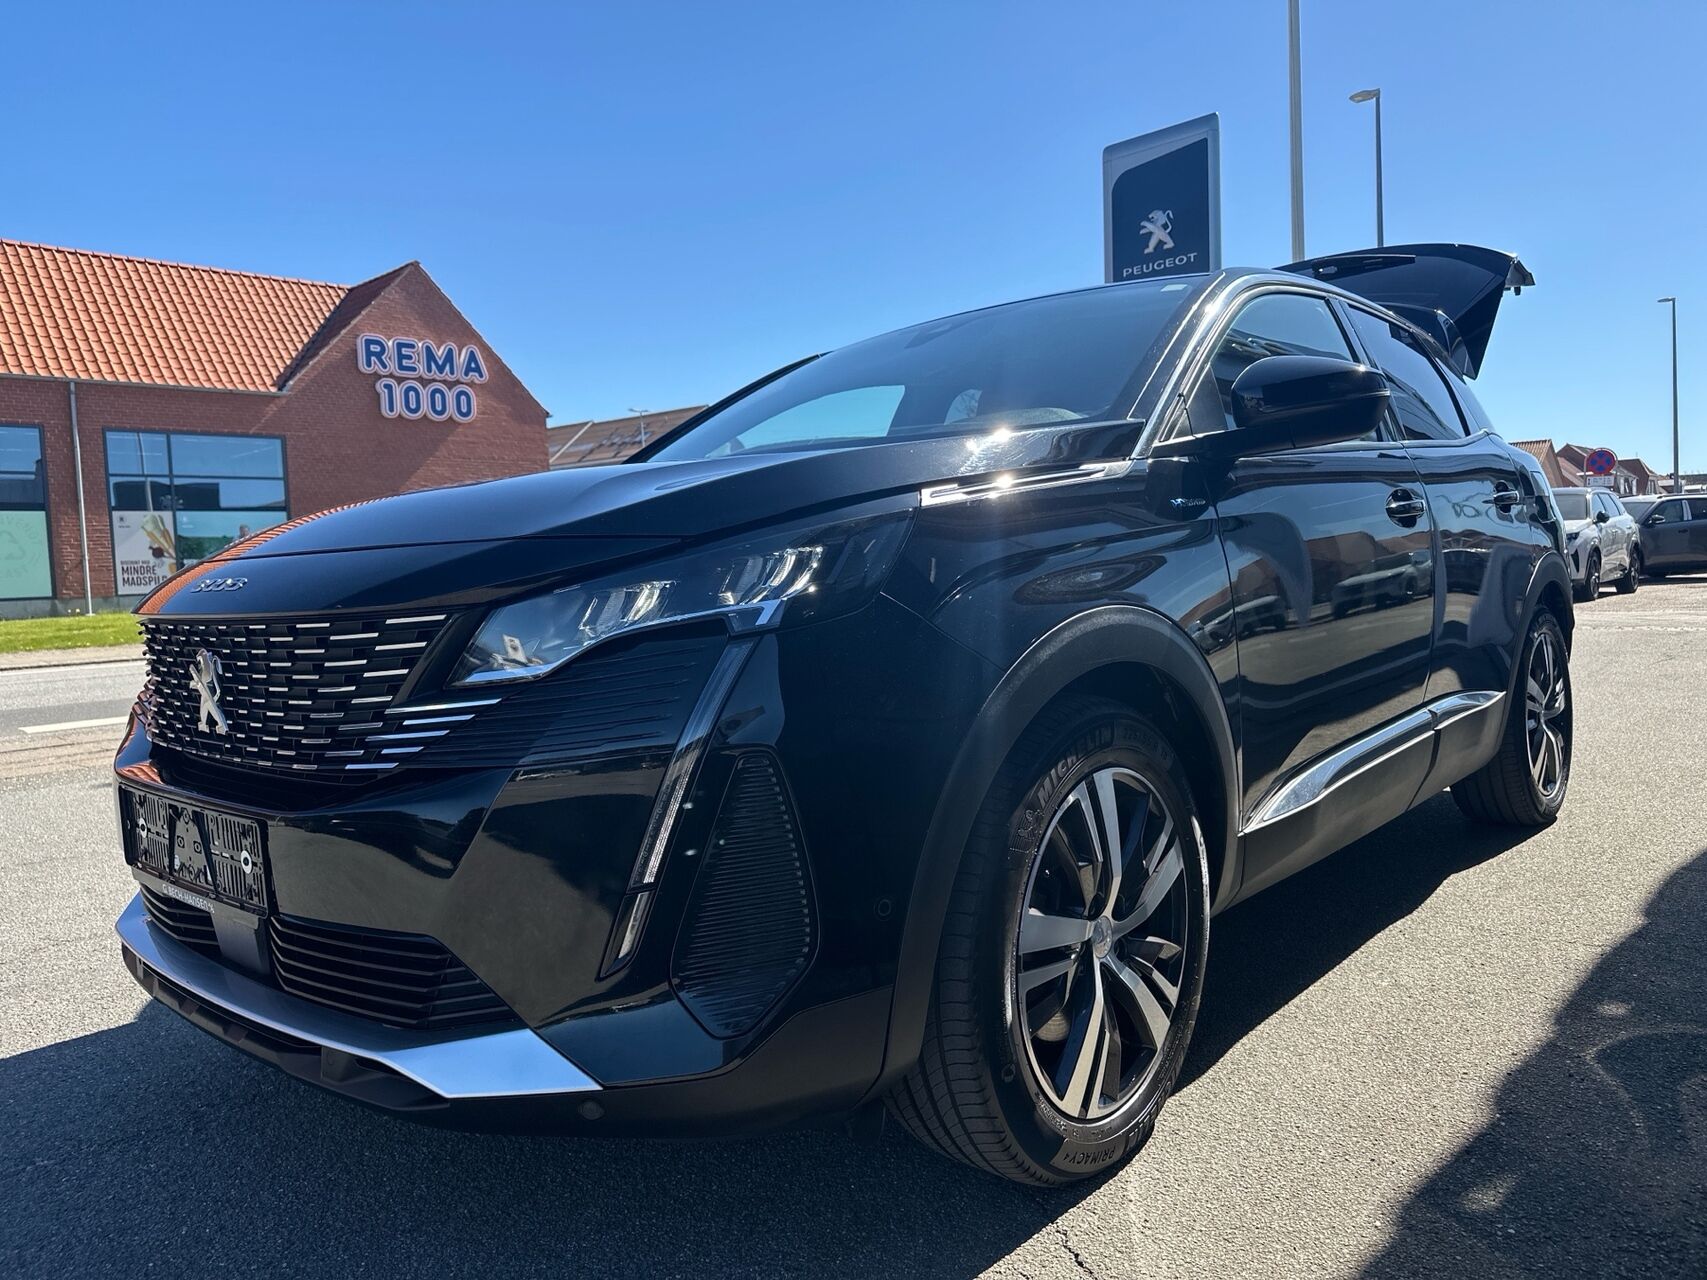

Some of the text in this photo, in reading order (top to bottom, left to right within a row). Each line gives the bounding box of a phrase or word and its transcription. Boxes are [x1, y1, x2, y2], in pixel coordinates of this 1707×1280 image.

[1123, 252, 1197, 277] PEUGEOT
[359, 335, 486, 381] REMA
[378, 380, 475, 420] 1000
[121, 565, 157, 576] MINDRE
[1069, 1146, 1116, 1165] PRIMACY
